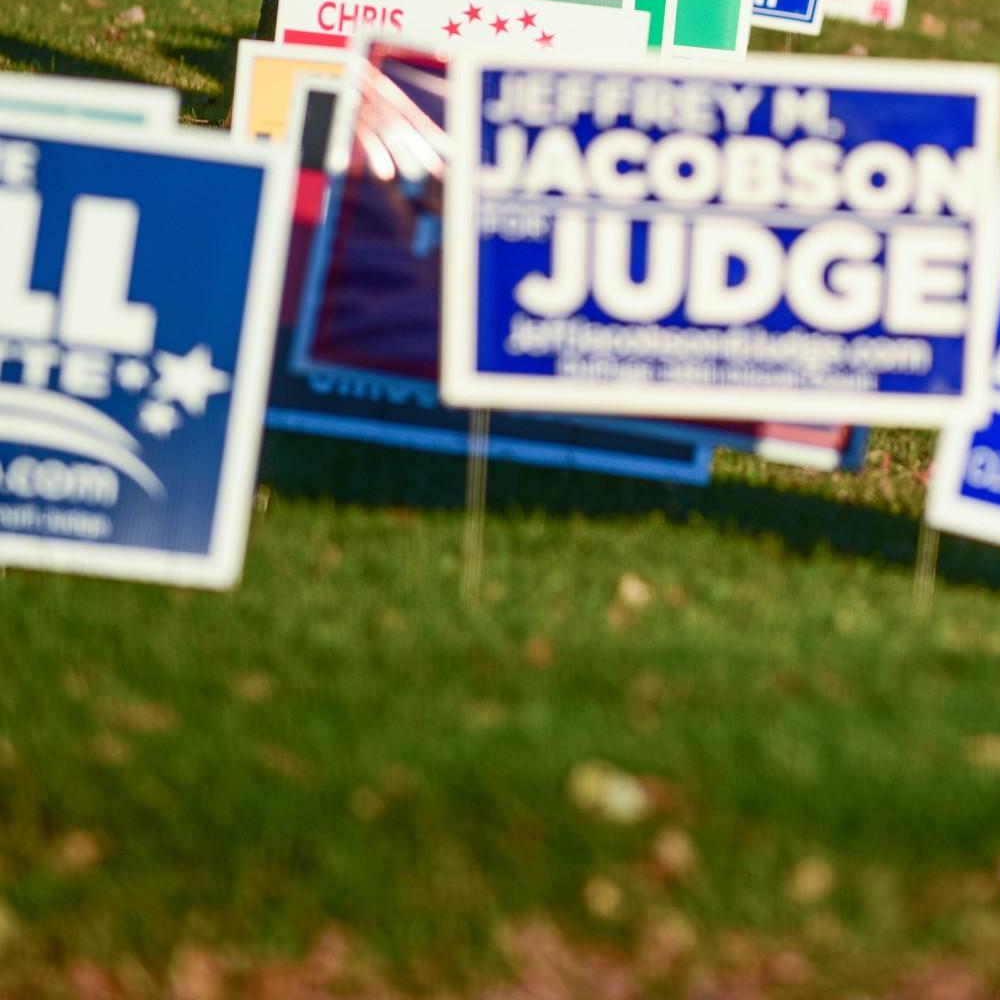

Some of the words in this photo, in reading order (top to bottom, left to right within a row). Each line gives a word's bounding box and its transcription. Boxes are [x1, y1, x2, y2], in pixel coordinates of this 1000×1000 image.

[317, 0, 404, 34] CHRIS
[481, 72, 762, 137] JEFFREY
[770, 86, 846, 141] M.
[477, 123, 976, 217] JACOBSON
[479, 203, 554, 242] FOR
[514, 208, 968, 335] JUDGE
